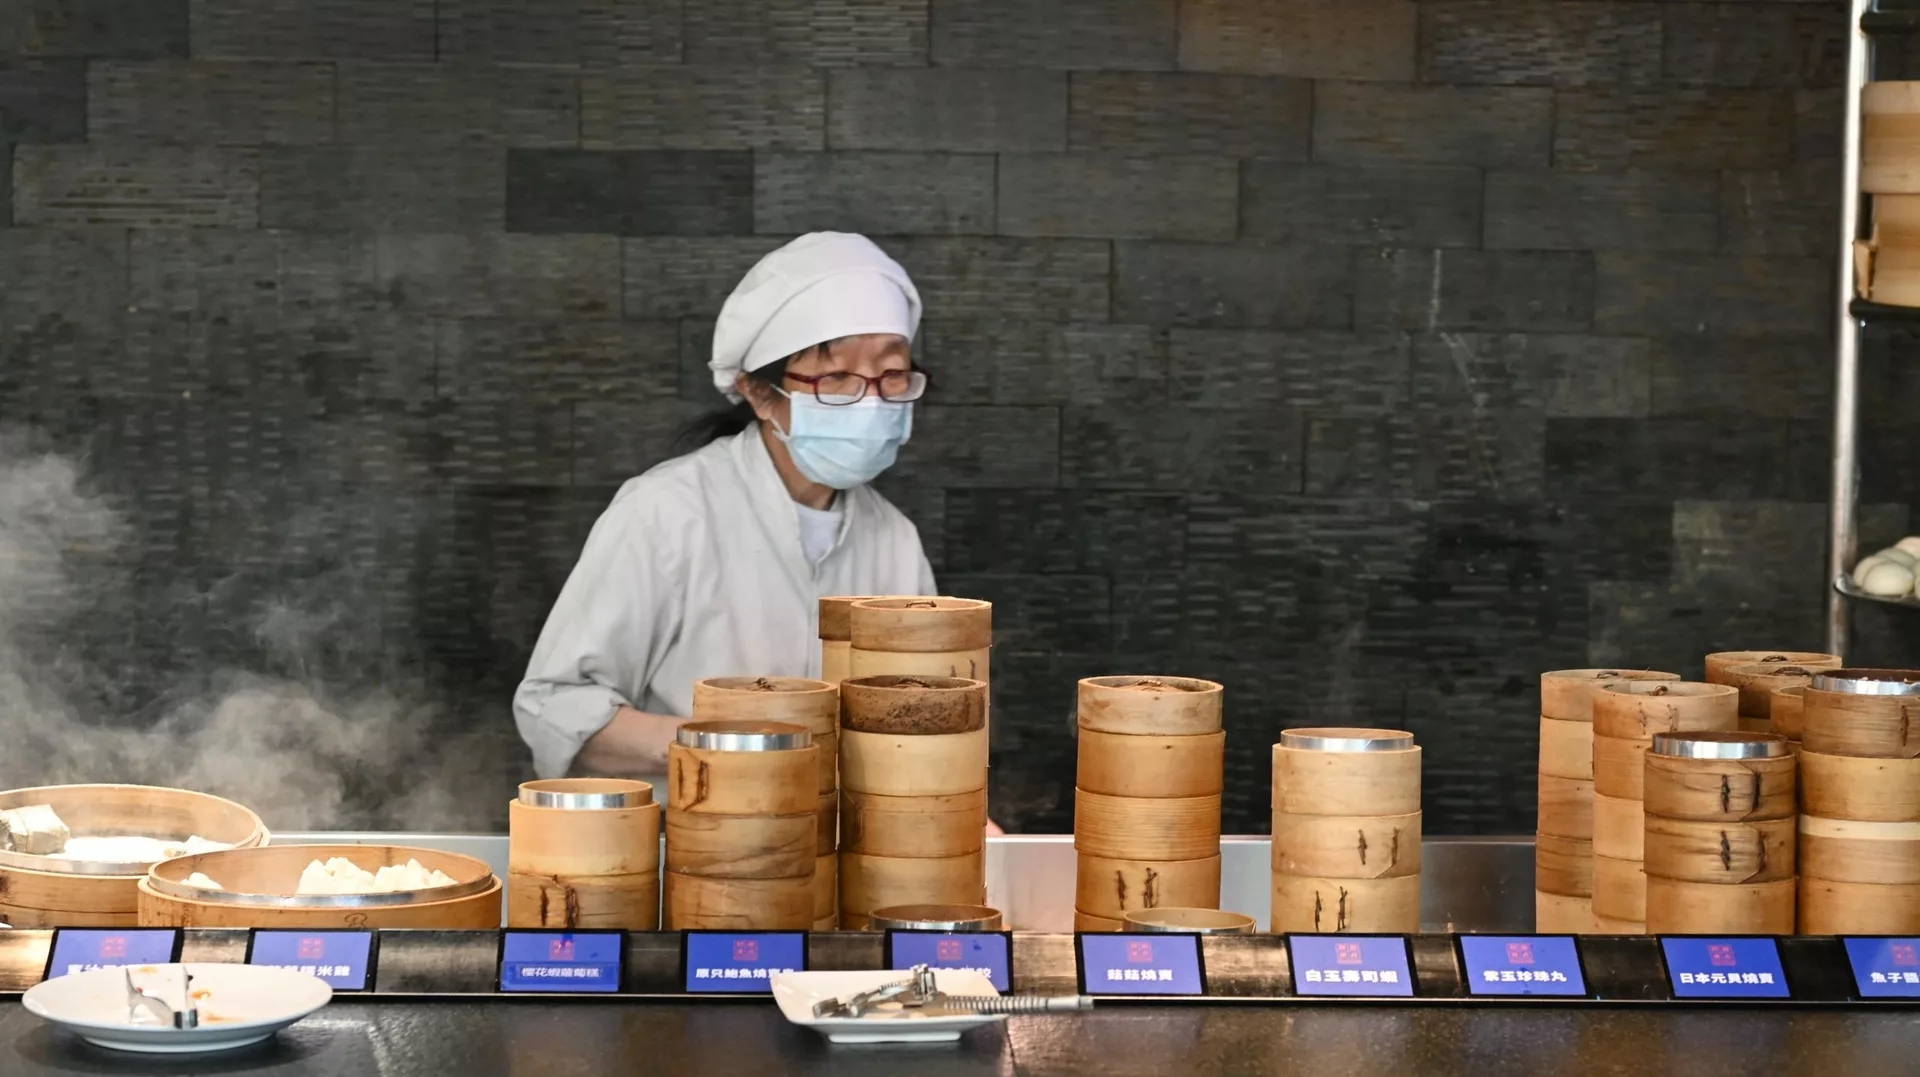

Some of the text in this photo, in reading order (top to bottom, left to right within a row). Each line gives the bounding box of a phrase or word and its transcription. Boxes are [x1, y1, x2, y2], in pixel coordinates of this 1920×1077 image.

[1305, 969, 1399, 983] 白玉壽司蝦
[1483, 970, 1567, 982] 紫玉珍珠丸
[1679, 972, 1775, 984] 日本元貝燒賣
[1870, 971, 1920, 984] 魚子醬
